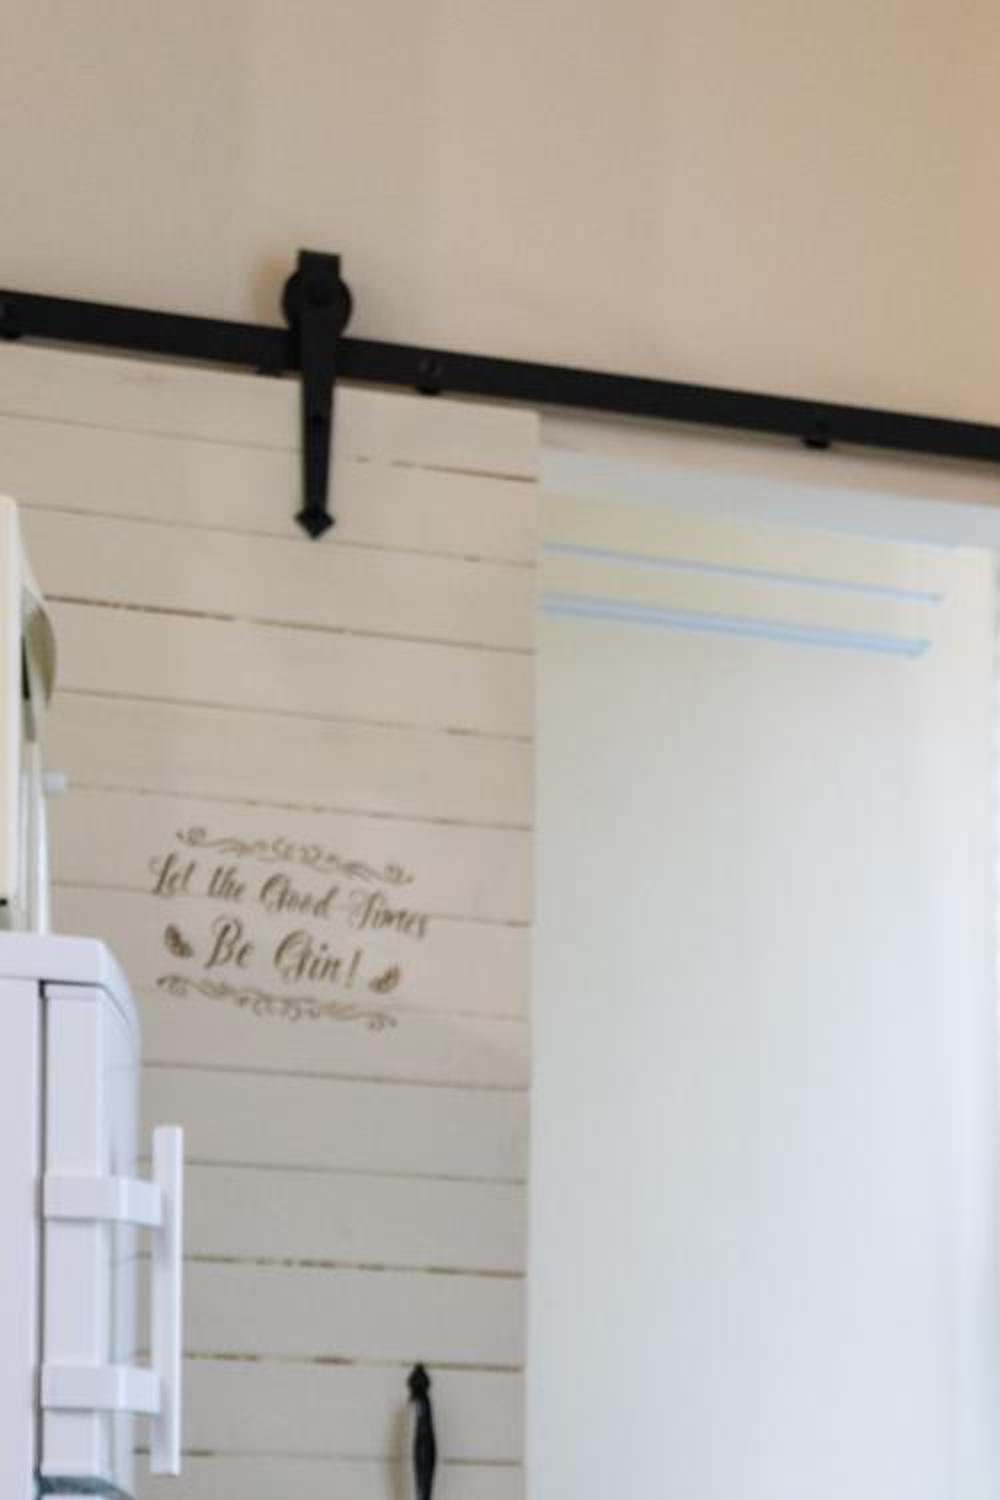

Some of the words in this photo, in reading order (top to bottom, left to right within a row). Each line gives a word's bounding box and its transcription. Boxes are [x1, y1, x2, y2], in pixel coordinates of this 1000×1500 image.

[148, 853, 196, 898] Let
[207, 866, 246, 901] the
[259, 873, 339, 917] Good
[349, 888, 431, 940] Times
[203, 914, 253, 969] Be
[273, 929, 363, 989] Gin!
